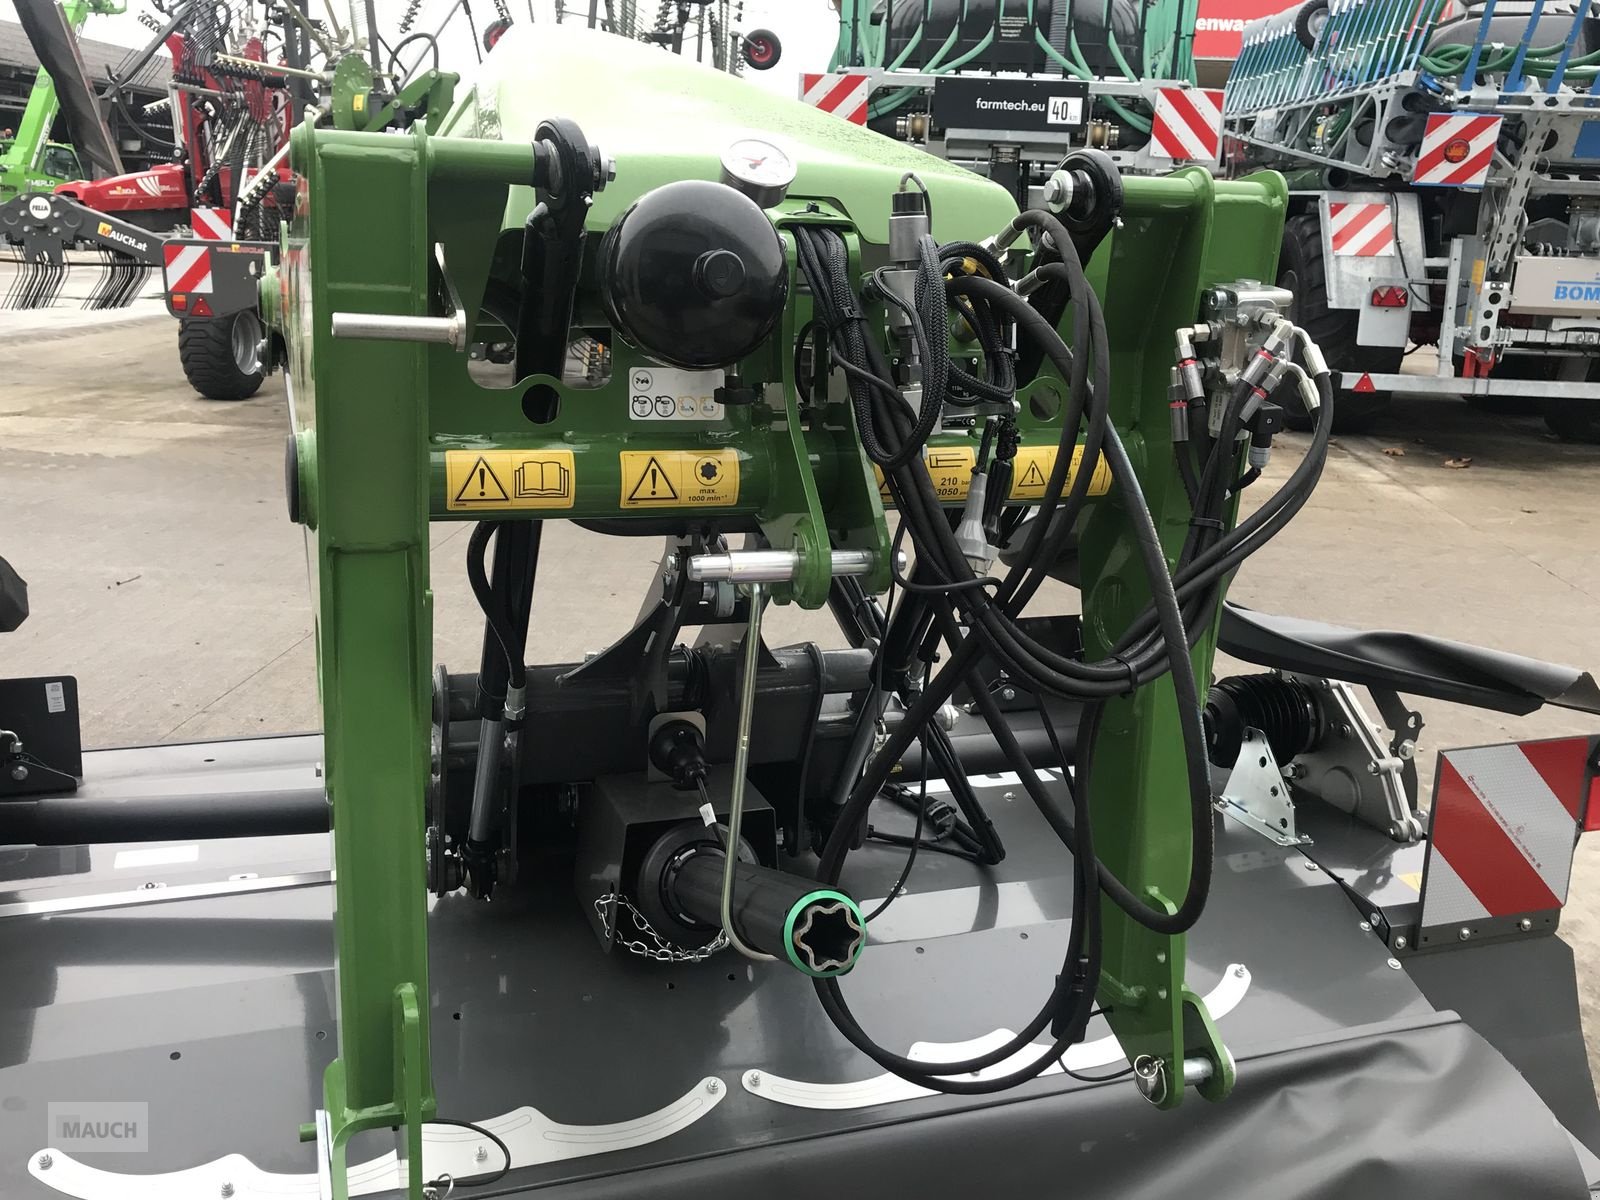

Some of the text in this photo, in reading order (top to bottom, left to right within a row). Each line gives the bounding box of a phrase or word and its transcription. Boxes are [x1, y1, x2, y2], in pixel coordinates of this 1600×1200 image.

[976, 98, 1046, 112] farmtech.eu
[1052, 101, 1069, 120] 40
[101, 226, 148, 251] MAUCH.at
[940, 477, 958, 486] 210
[936, 488, 959, 496] 3050
